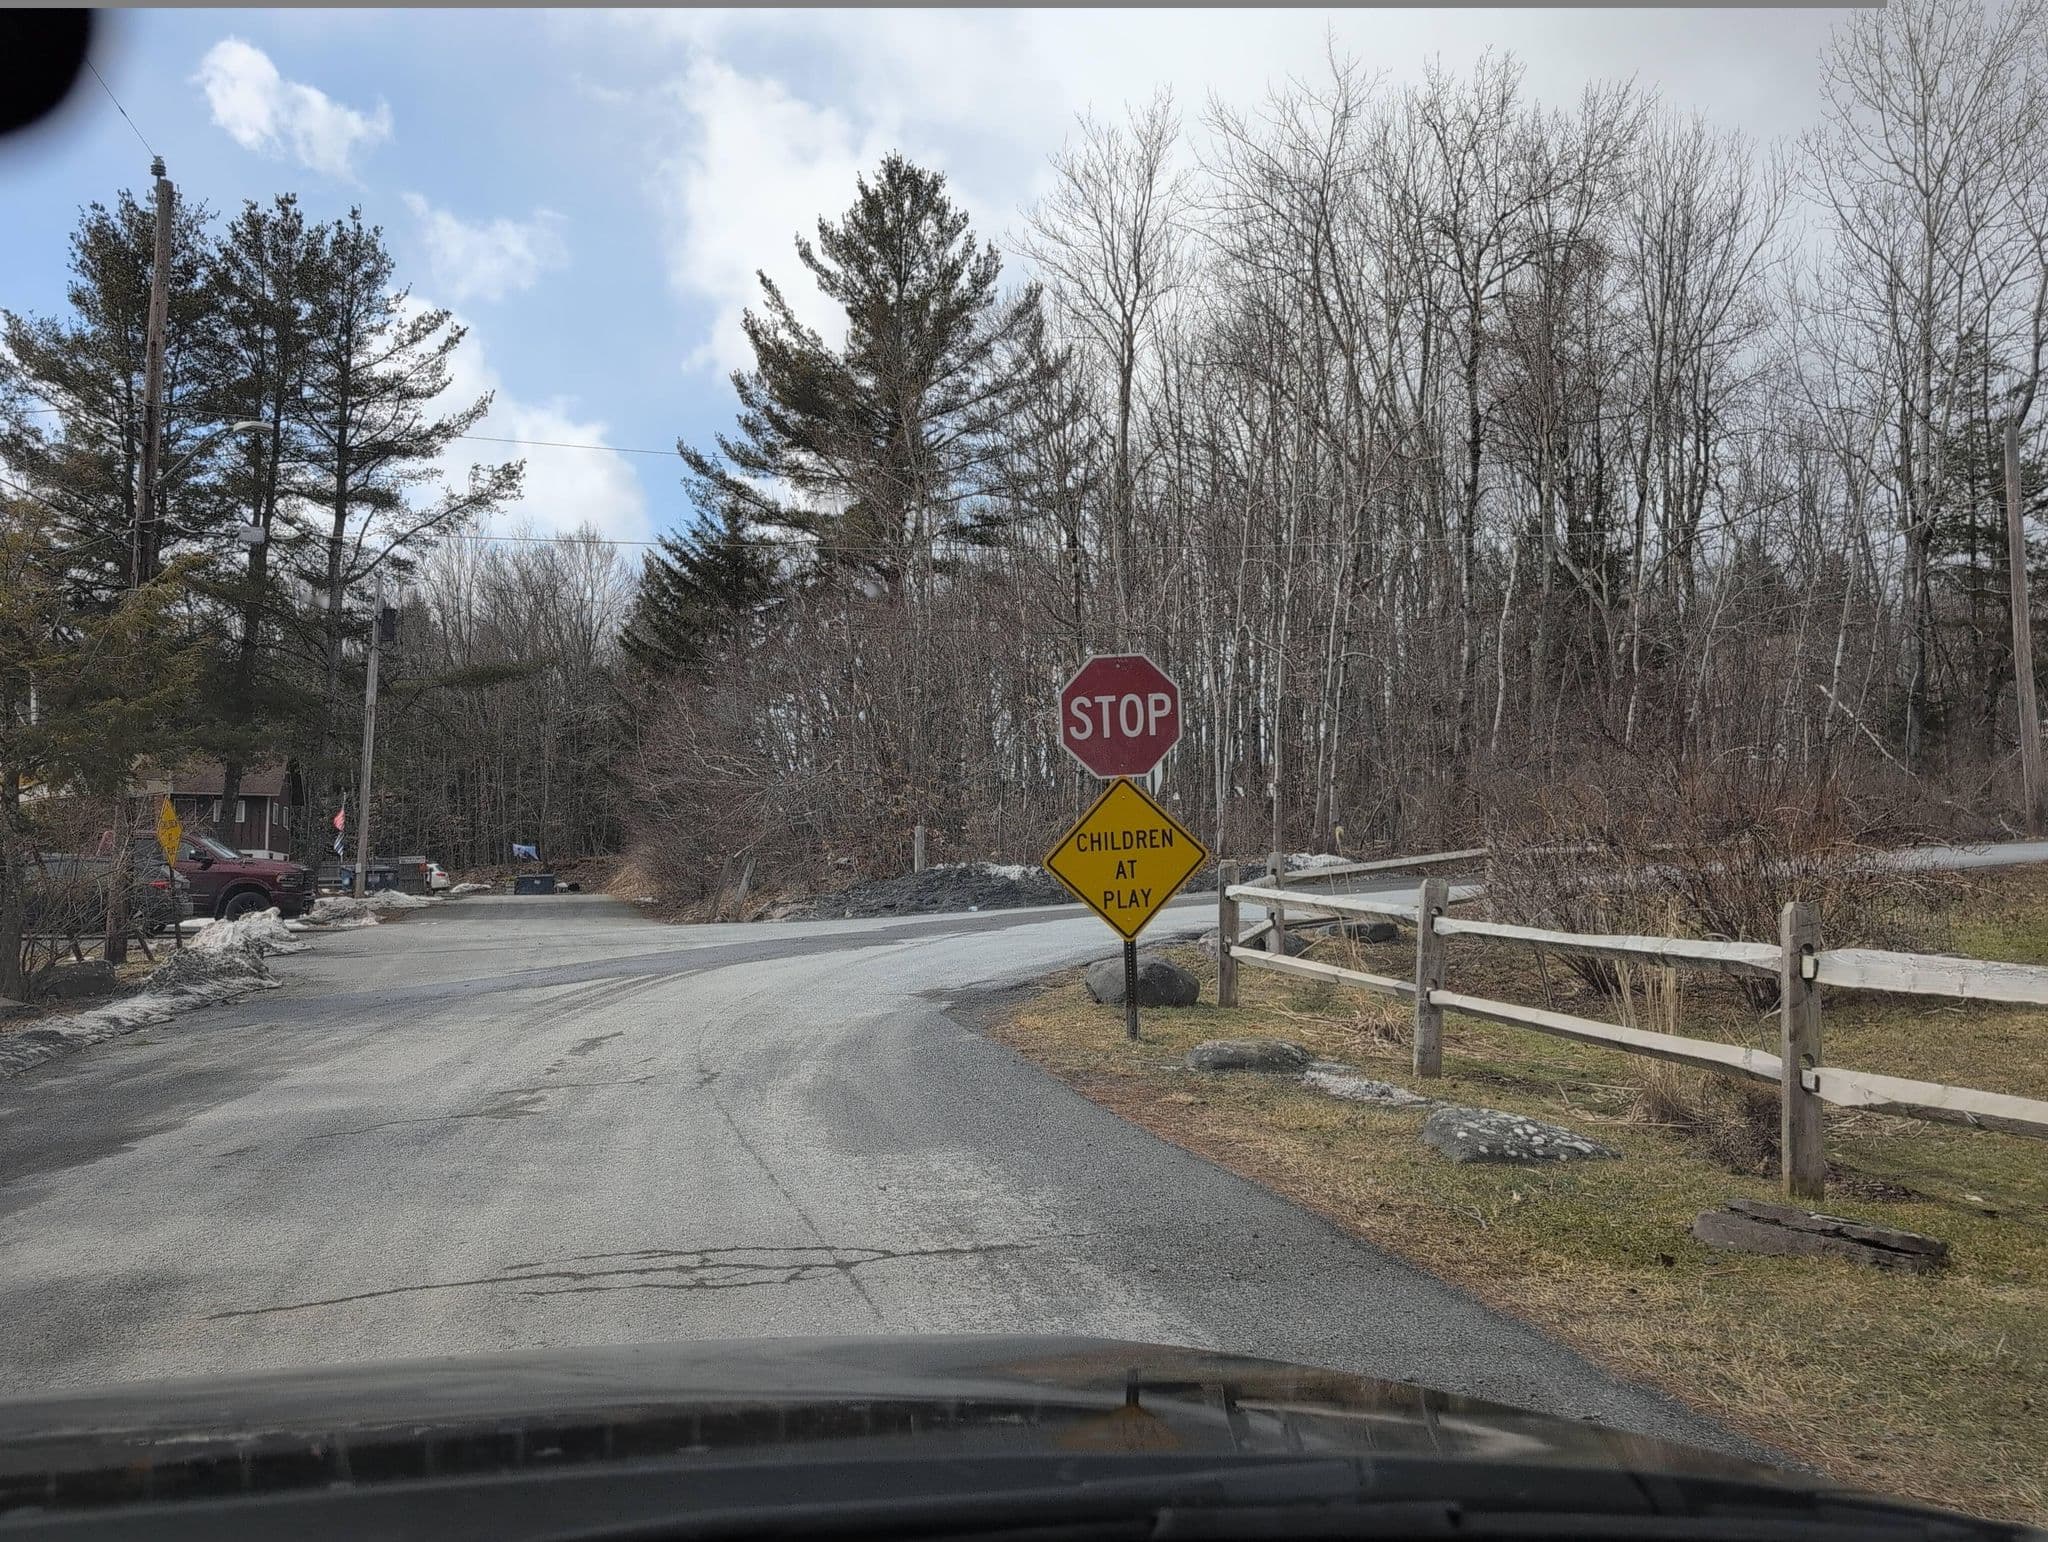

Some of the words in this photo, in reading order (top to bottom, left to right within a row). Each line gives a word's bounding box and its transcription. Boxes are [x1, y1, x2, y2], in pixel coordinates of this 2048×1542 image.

[1070, 693, 1172, 740] STOP
[1076, 828, 1174, 853] CHILDREN
[1115, 860, 1137, 880] AT
[1103, 888, 1152, 910] PLAY
